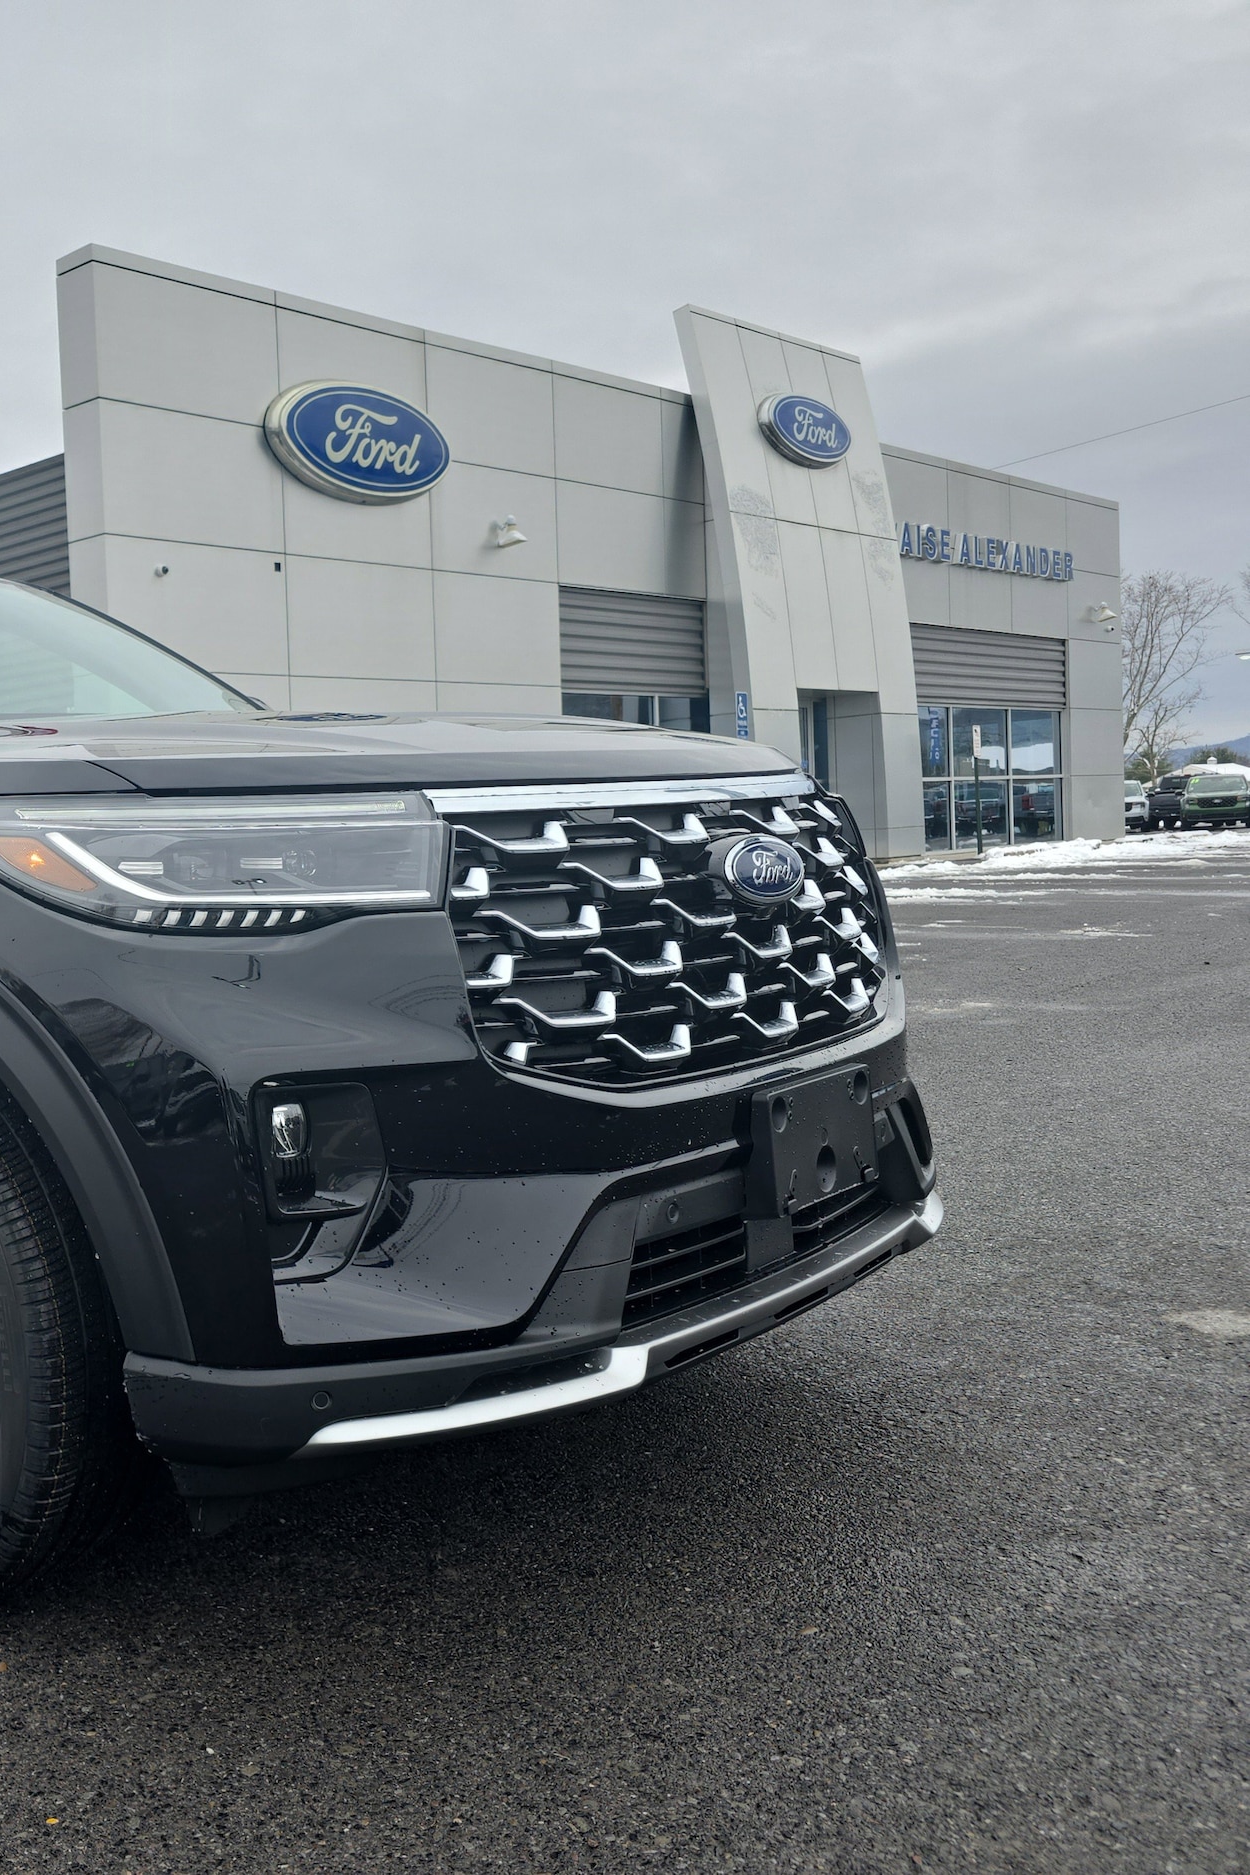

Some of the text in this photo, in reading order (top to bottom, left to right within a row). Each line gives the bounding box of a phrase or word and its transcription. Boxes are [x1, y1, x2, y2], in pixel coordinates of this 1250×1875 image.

[325, 403, 422, 475] Ford
[793, 405, 838, 449] Ford
[895, 520, 1075, 581] AISE ALEXANDER
[752, 850, 794, 886] Ford
